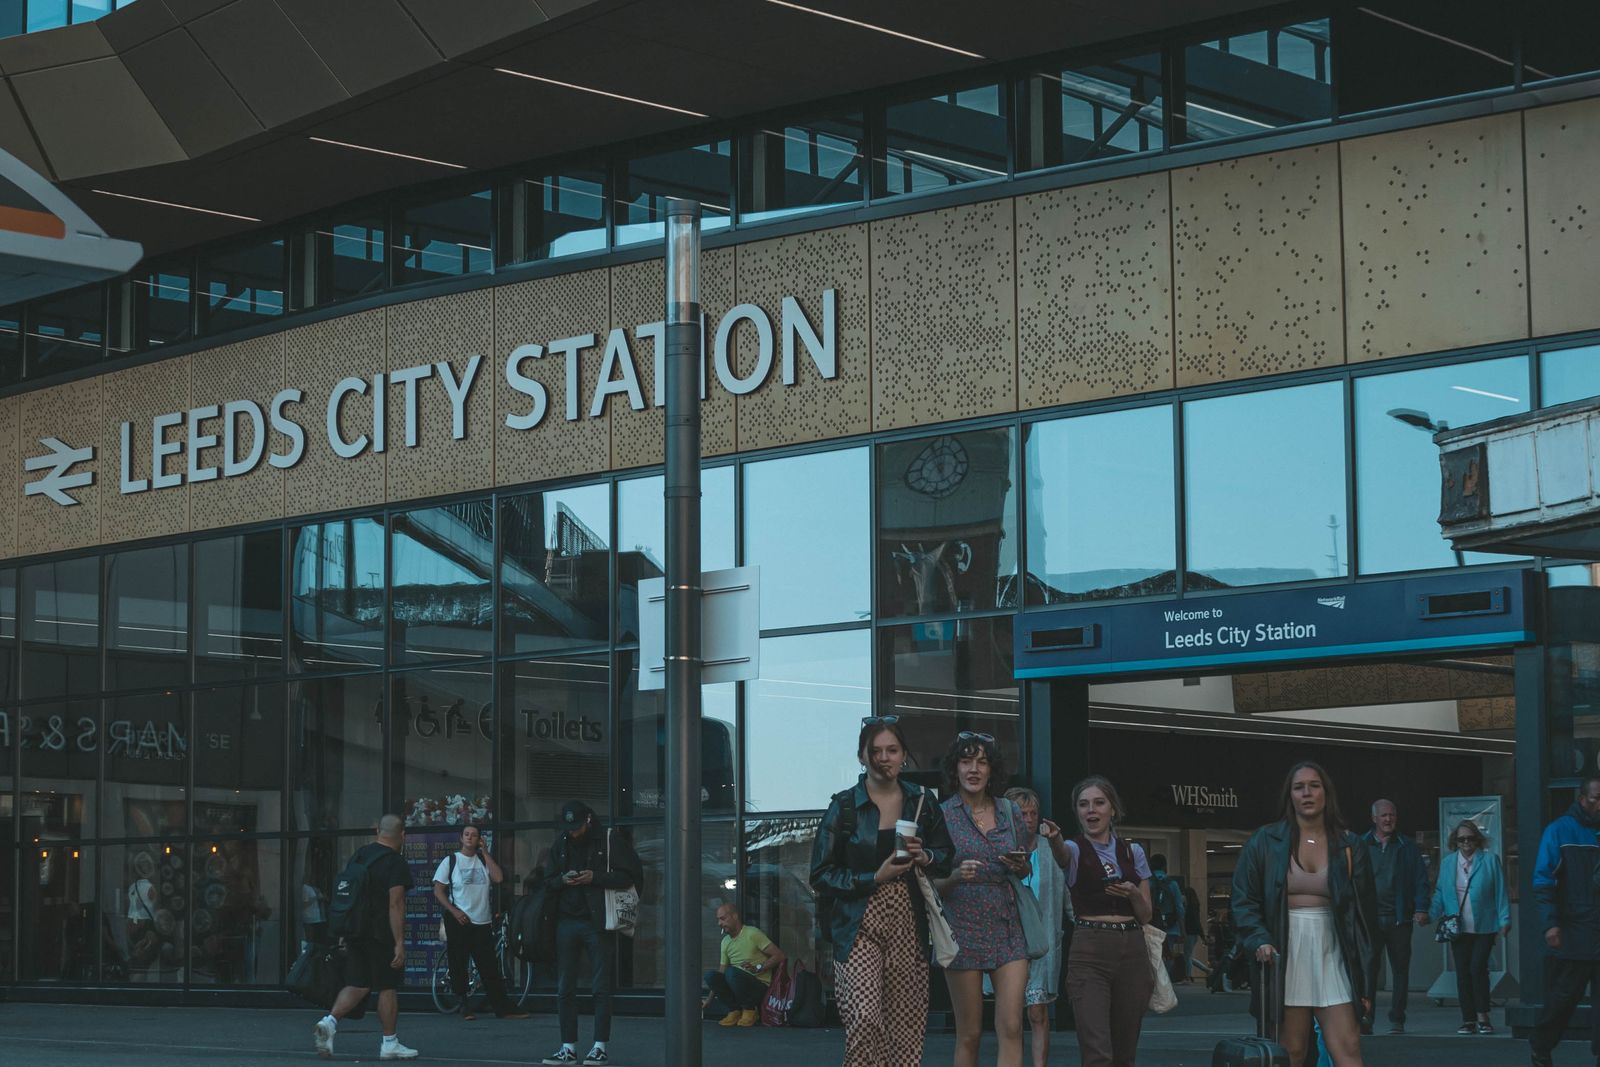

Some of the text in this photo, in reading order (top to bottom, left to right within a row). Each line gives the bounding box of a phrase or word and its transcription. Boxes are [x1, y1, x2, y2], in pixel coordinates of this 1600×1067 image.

[120, 388, 306, 496] LEEDS
[326, 354, 485, 460] CITY
[1164, 607, 1223, 623] Welcome to
[1164, 621, 1317, 649] Leeds City Station
[520, 709, 602, 742] Toilets
[1171, 784, 1239, 808] WHSmith
